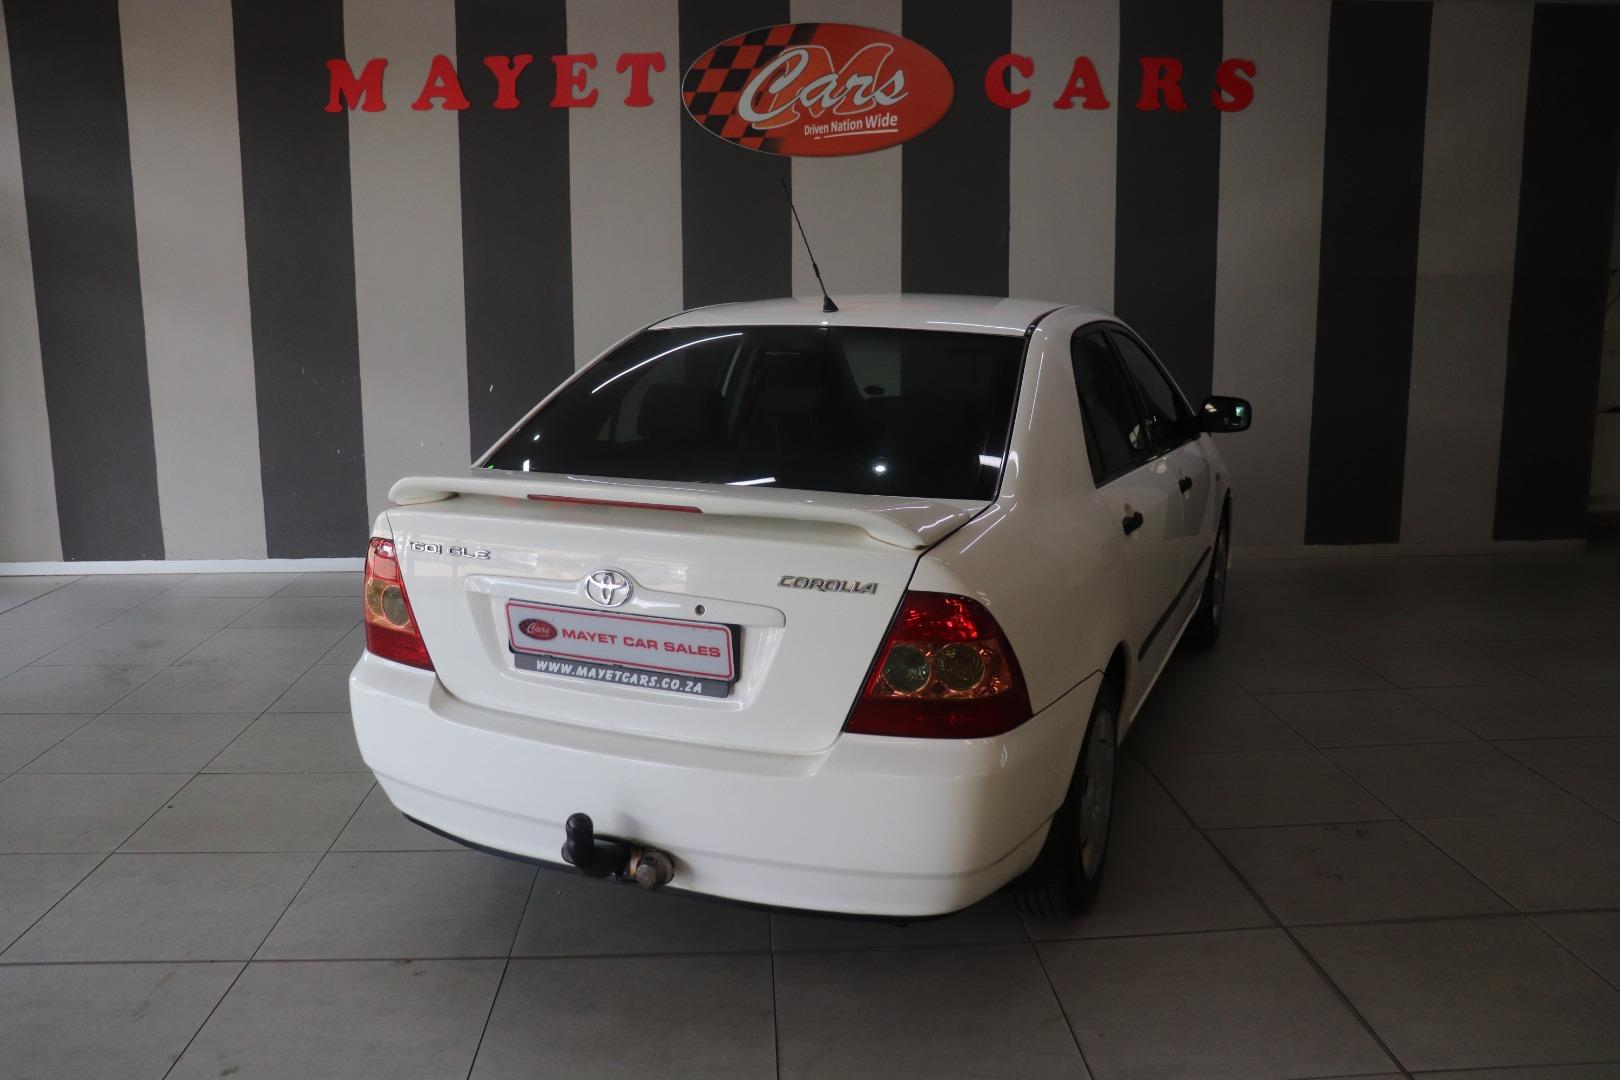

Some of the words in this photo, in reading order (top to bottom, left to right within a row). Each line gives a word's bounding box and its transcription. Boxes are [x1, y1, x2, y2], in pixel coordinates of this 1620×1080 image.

[325, 51, 666, 113] MAYET
[738, 47, 909, 123] Cars
[984, 53, 1257, 113] CARS
[804, 124, 830, 137] Driven
[830, 118, 863, 134] Nation
[865, 112, 898, 128] Wide
[777, 575, 879, 595] COROLLA
[562, 628, 618, 646] MAYET
[623, 635, 658, 650] CAR
[663, 642, 721, 658] SALES
[536, 659, 702, 693] WWW.MAYETCARS.CO.ZA
